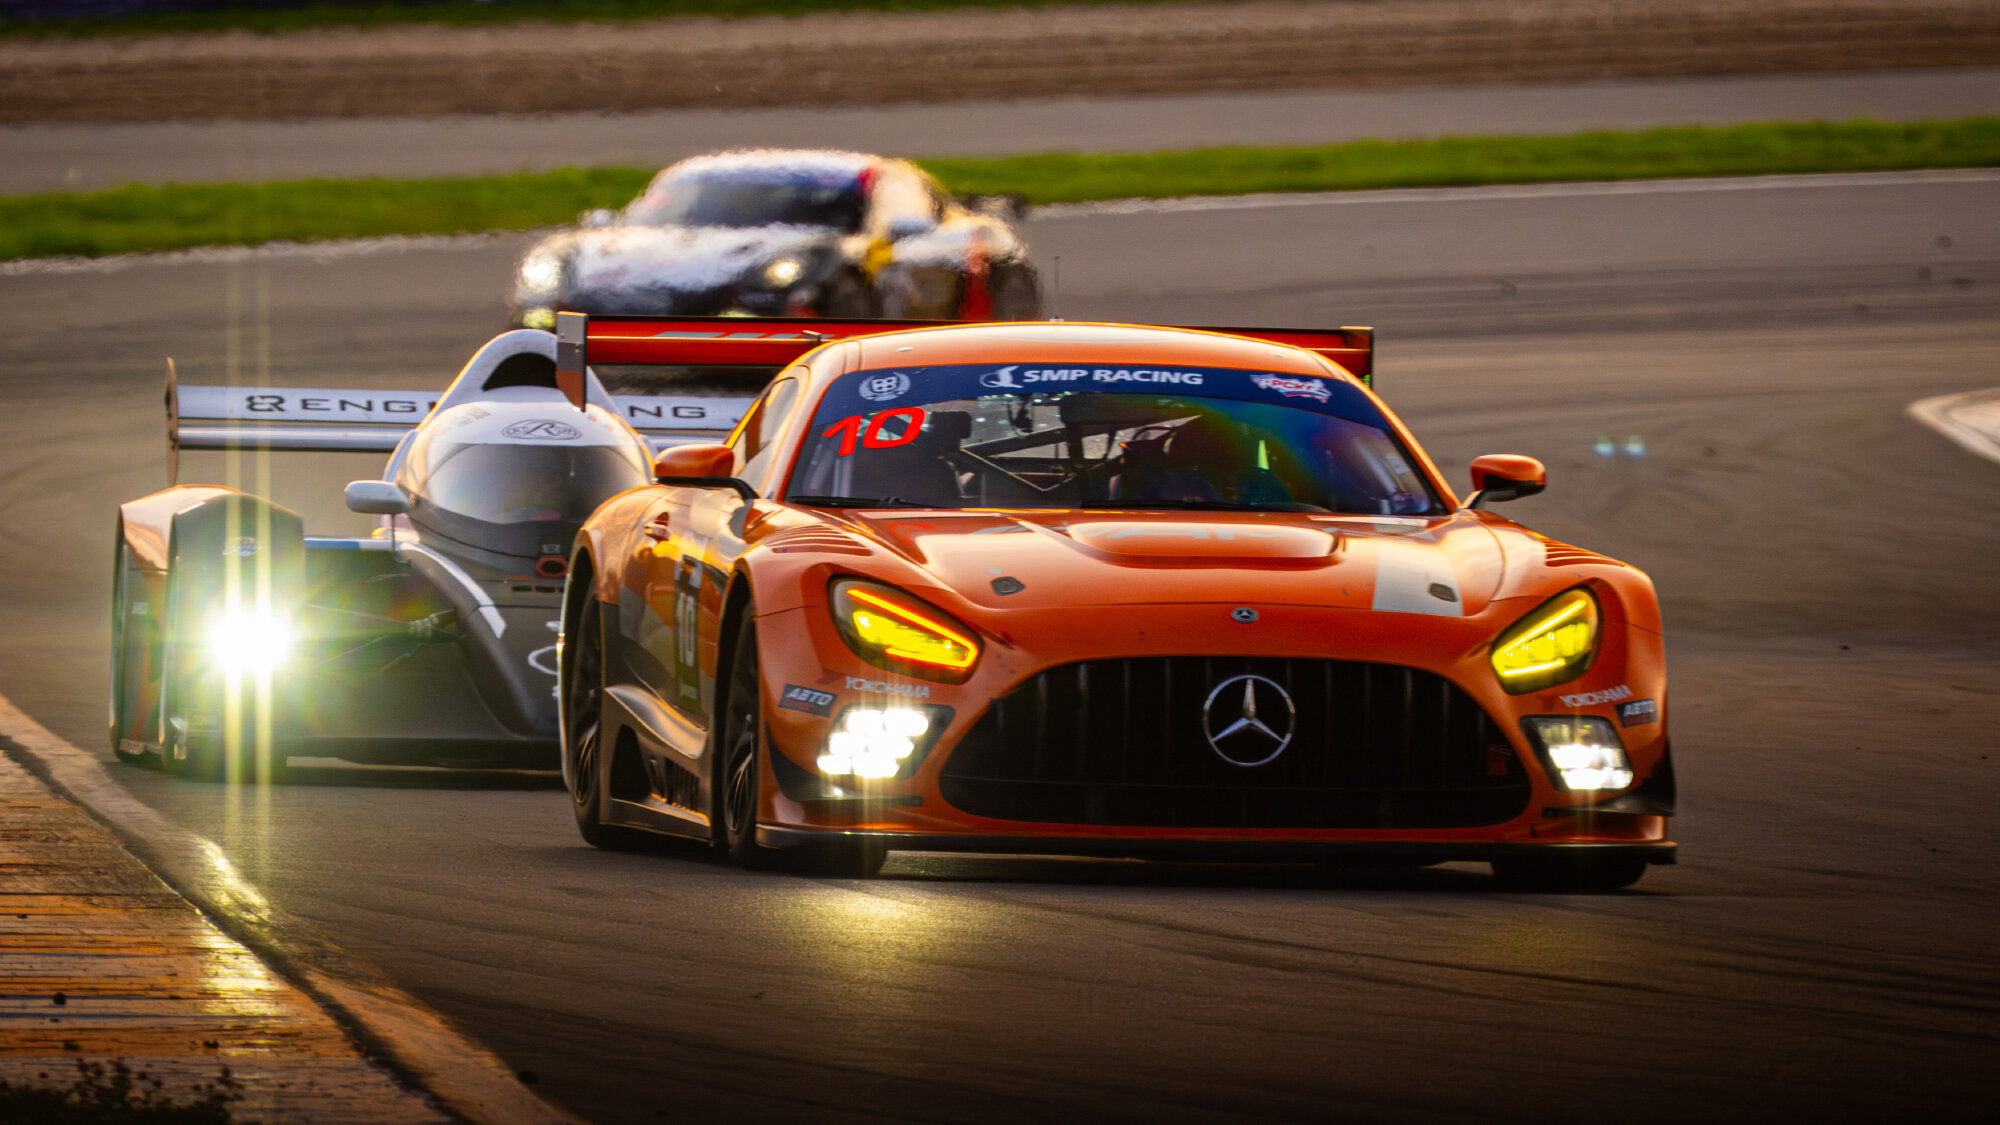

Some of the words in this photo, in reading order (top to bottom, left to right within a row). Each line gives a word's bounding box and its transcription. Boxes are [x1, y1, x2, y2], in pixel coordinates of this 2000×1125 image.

[1022, 369, 1088, 383] SMP
[1092, 369, 1204, 385] RACING
[822, 406, 926, 457] 10
[845, 675, 931, 698] YOKOHAMA
